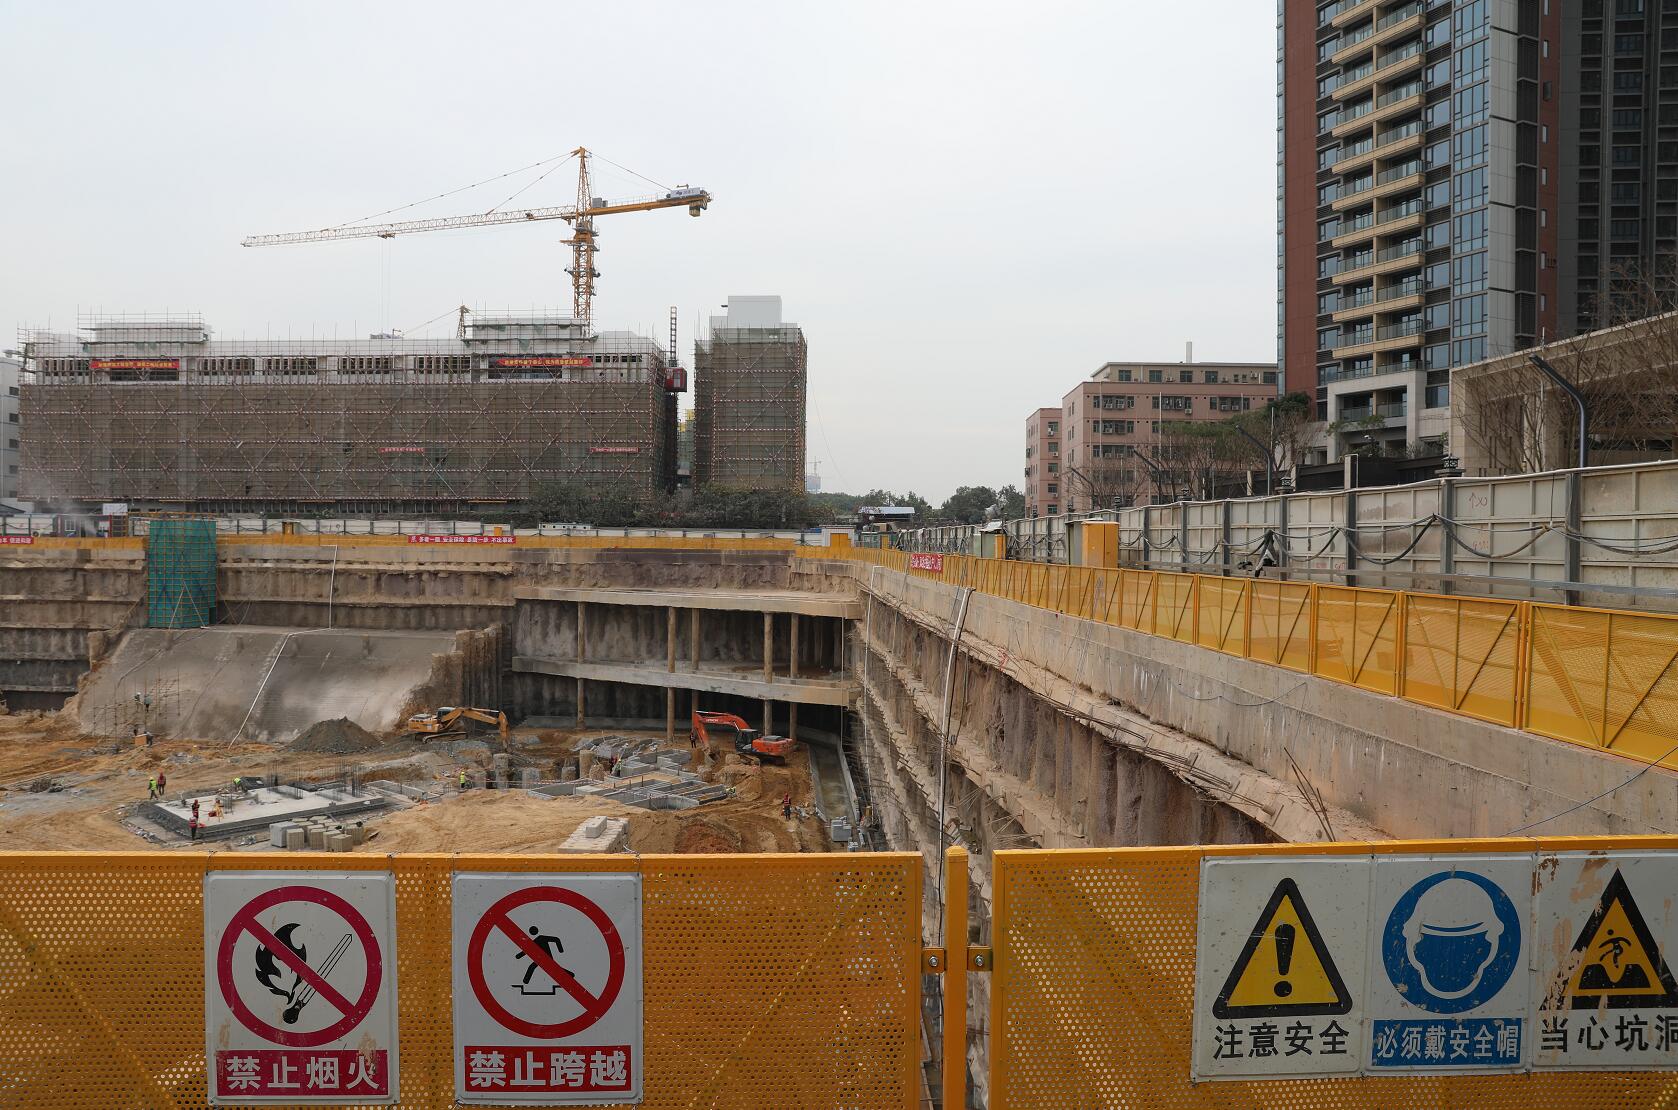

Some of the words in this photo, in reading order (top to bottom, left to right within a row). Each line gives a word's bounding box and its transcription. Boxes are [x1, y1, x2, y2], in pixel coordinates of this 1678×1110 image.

[1212, 1019, 1350, 1060] 注意安全
[1376, 1023, 1519, 1059] 必须戴安全帽
[225, 1057, 380, 1090] 禁止烟火
[468, 1050, 627, 1088] 禁止跨越
